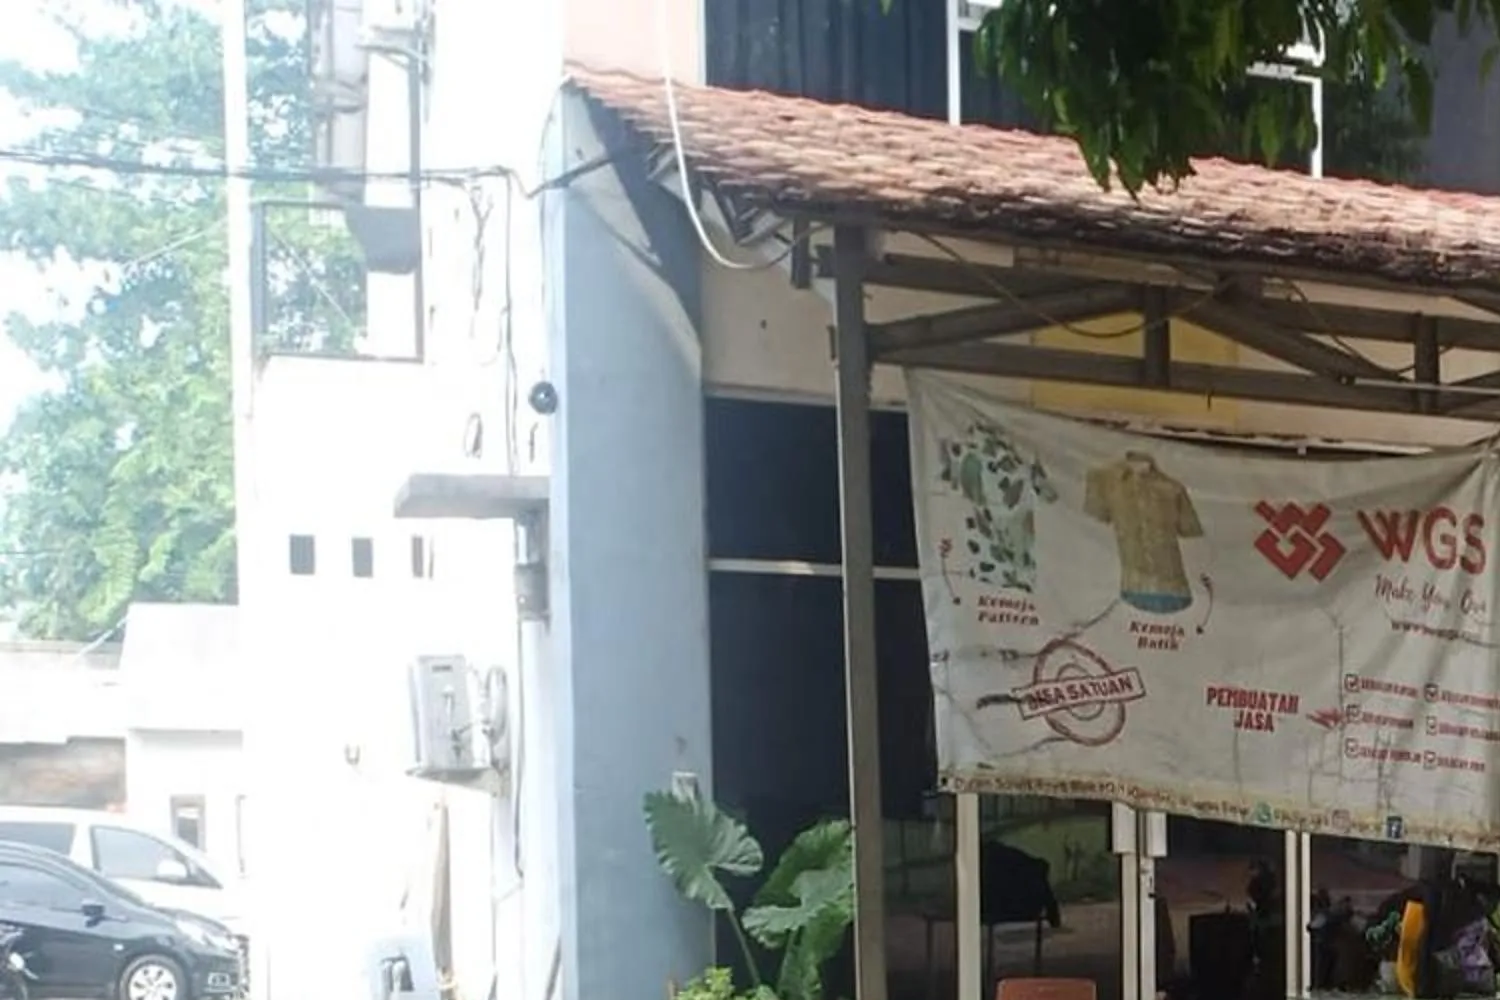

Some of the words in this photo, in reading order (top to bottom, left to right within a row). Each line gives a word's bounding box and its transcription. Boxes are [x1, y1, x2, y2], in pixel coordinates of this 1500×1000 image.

[1357, 507, 1486, 575] WGS
[978, 611, 1039, 626] Pattern
[1137, 636, 1179, 650] Batik
[1066, 674, 1133, 700] SATUAN
[1206, 687, 1299, 714] PEMBUATAN
[1233, 710, 1274, 732] JASA
